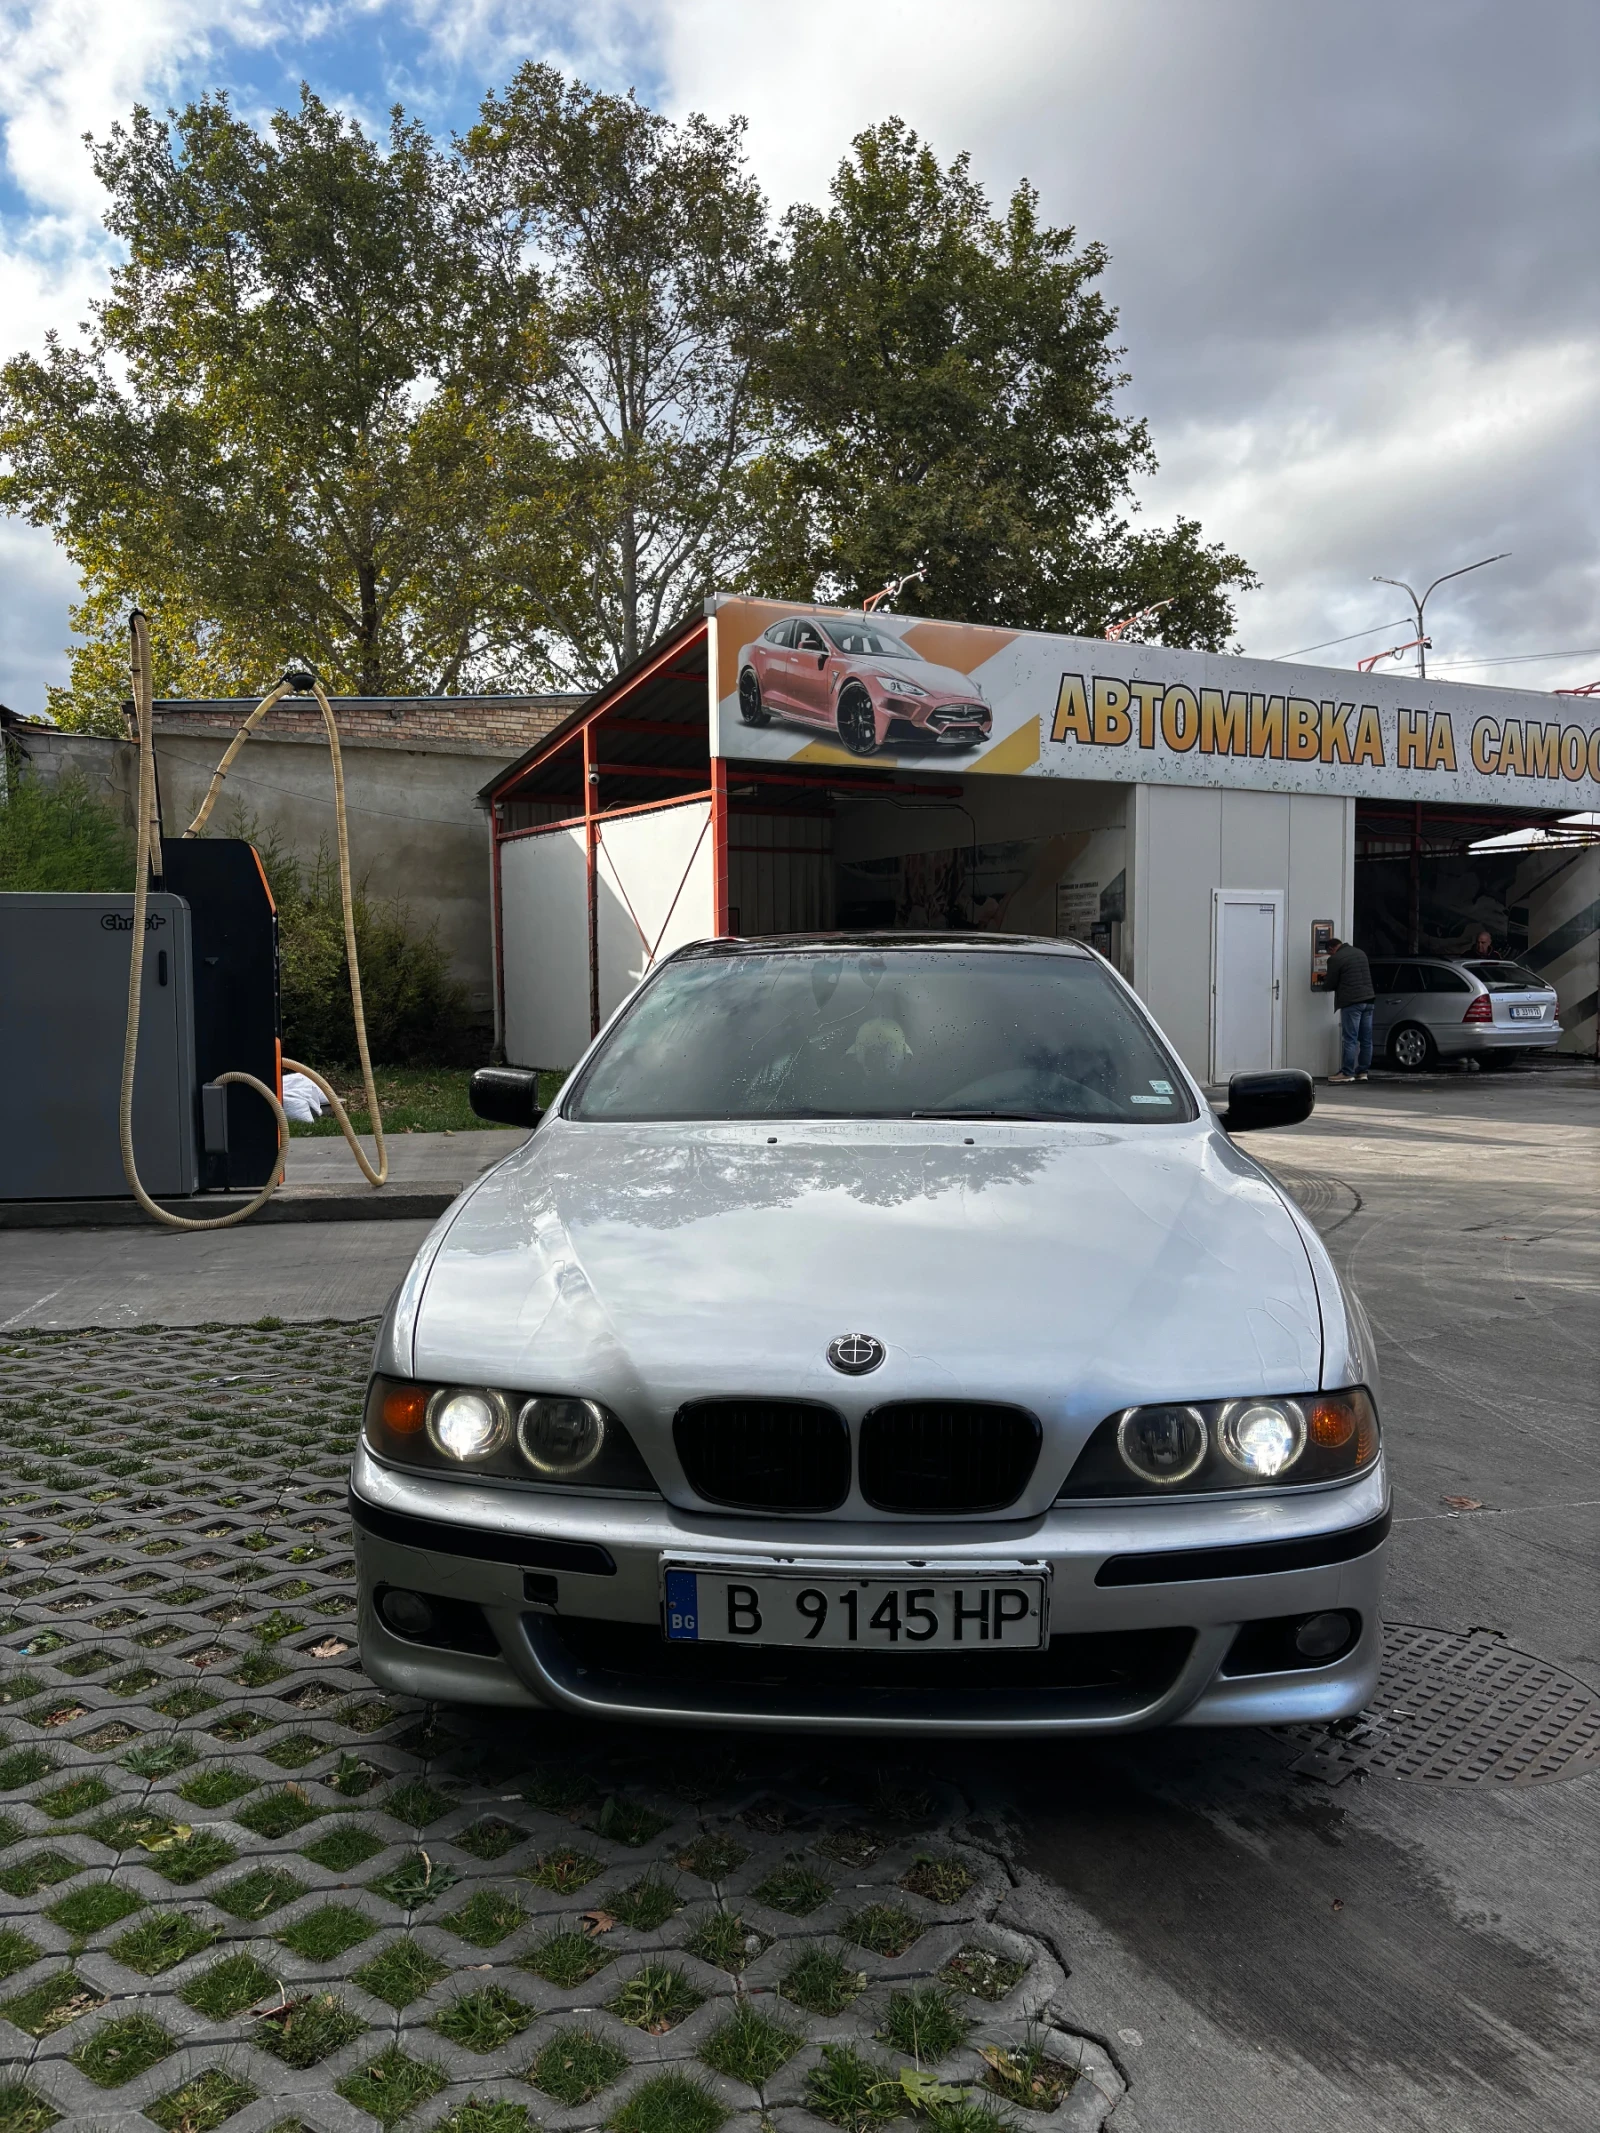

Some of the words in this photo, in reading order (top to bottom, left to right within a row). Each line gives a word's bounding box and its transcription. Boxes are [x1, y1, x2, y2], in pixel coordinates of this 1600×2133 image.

[1049, 673, 1386, 767] АВТОМИВКА
[1397, 708, 1458, 772] НА
[834, 1333, 879, 1346] BMW
[671, 1613, 696, 1630] BG
[727, 1584, 763, 1635] B
